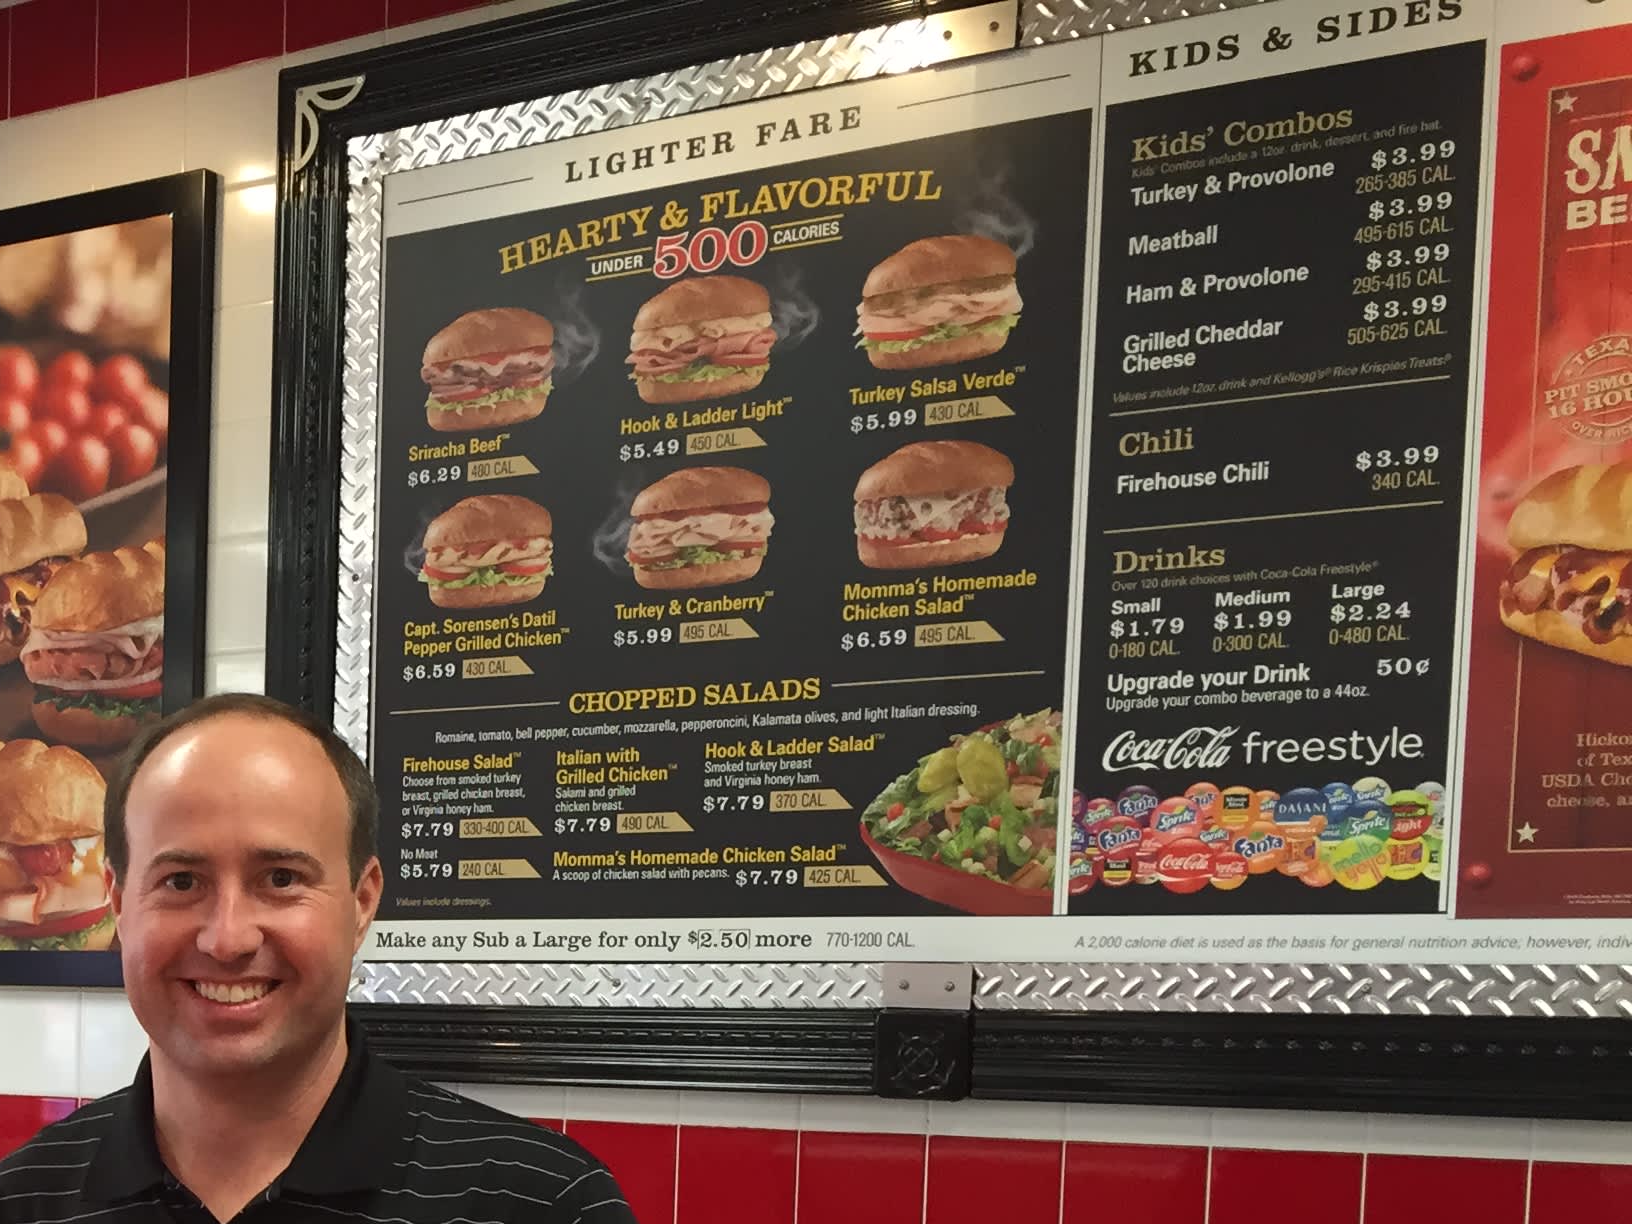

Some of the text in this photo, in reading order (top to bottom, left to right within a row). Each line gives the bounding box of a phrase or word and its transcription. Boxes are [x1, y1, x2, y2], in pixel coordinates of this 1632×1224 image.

[1129, 0, 1462, 78] KIDS & SIDES
[565, 105, 861, 184] LIGHTER FARE
[1131, 109, 1353, 163] Kids' Combos
[1371, 139, 1456, 172] $3.99
[1130, 161, 1335, 207] Turkey & Provolone
[1355, 169, 1417, 195] 265-385
[1368, 191, 1453, 222] $3.99
[498, 170, 942, 274] HEARTY & FLAVORFUL
[1353, 220, 1414, 244] 495-615
[591, 220, 840, 279] UNDER 500 CALORIES
[1128, 224, 1218, 256] Meatball
[1366, 243, 1450, 273] $3.99
[1126, 266, 1309, 305] Ham & Provolone
[1352, 271, 1412, 295] 295-415
[1363, 294, 1447, 323] $3.99
[1123, 319, 1284, 356] Grilled Cheddar
[1122, 352, 1196, 374] Cheese
[848, 377, 957, 405] Turkey Salsa
[1544, 384, 1580, 404] PIT
[620, 406, 738, 435] Hook & Ladder
[850, 408, 917, 435] $5.99
[1549, 401, 1576, 418] 16
[408, 441, 466, 462] Sriracha
[619, 438, 679, 462] $5.49
[1119, 426, 1194, 457] Chili
[1355, 445, 1439, 472] $3.99
[407, 465, 461, 488] $6.29
[1117, 460, 1270, 495] Firehouse Chili
[1112, 546, 1225, 574] Drinks
[844, 568, 1037, 601] Momma's Homemade
[1331, 583, 1385, 601] Large
[614, 599, 682, 621] Turkey &
[1111, 597, 1161, 615] Small
[1215, 589, 1291, 608] Medium
[842, 601, 910, 622] Chicken
[1213, 609, 1292, 632] $1.99
[1330, 601, 1411, 624] $2.24
[404, 609, 556, 640] Capt. Sorensen's Datil
[1110, 617, 1185, 639] $1.79
[1328, 626, 1372, 645] 0-480
[404, 633, 502, 658] Pepper Grilled
[613, 627, 672, 648] $5.99
[841, 629, 907, 652] $6.59
[1212, 634, 1253, 653] 0-300
[1108, 641, 1146, 660] 0-180
[402, 662, 456, 683] $6.59
[1107, 662, 1311, 696] Upgrade your Drink
[568, 677, 820, 714] CHOPPED SALADS
[1106, 694, 1159, 712] Upgrade
[1161, 695, 1192, 710] your
[1193, 690, 1238, 706] combo
[1240, 689, 1303, 704] beverage
[1305, 687, 1319, 700] to
[1322, 687, 1332, 699] a
[571, 703, 980, 737] cucumber, mozzarella, pepperoncini, Kalamata olives, and light Italian dressing.
[556, 746, 640, 766] Italian with
[705, 737, 824, 759] Hook & Ladder
[1102, 725, 1239, 772] Coca-Cola
[1242, 726, 1424, 766] freestyle
[403, 756, 470, 773] Firehouse
[556, 767, 605, 785] Grilled
[703, 794, 765, 814] $7.79
[1279, 802, 1326, 814] DASANI
[401, 822, 454, 839] $7.79
[554, 817, 611, 835] $7.79
[1350, 815, 1386, 834] Sprite
[1098, 827, 1141, 850] Fanta
[1234, 834, 1283, 859] Fanta
[553, 847, 786, 867] Momma's Homemade Chicken
[400, 863, 453, 880] $5.79
[735, 869, 798, 888] $7.79
[375, 928, 812, 953] Make any Sub a Large for only $2.50 more
[826, 931, 883, 948] 770-1200
[1212, 935, 1592, 952] used the basis for general nutrition however,
